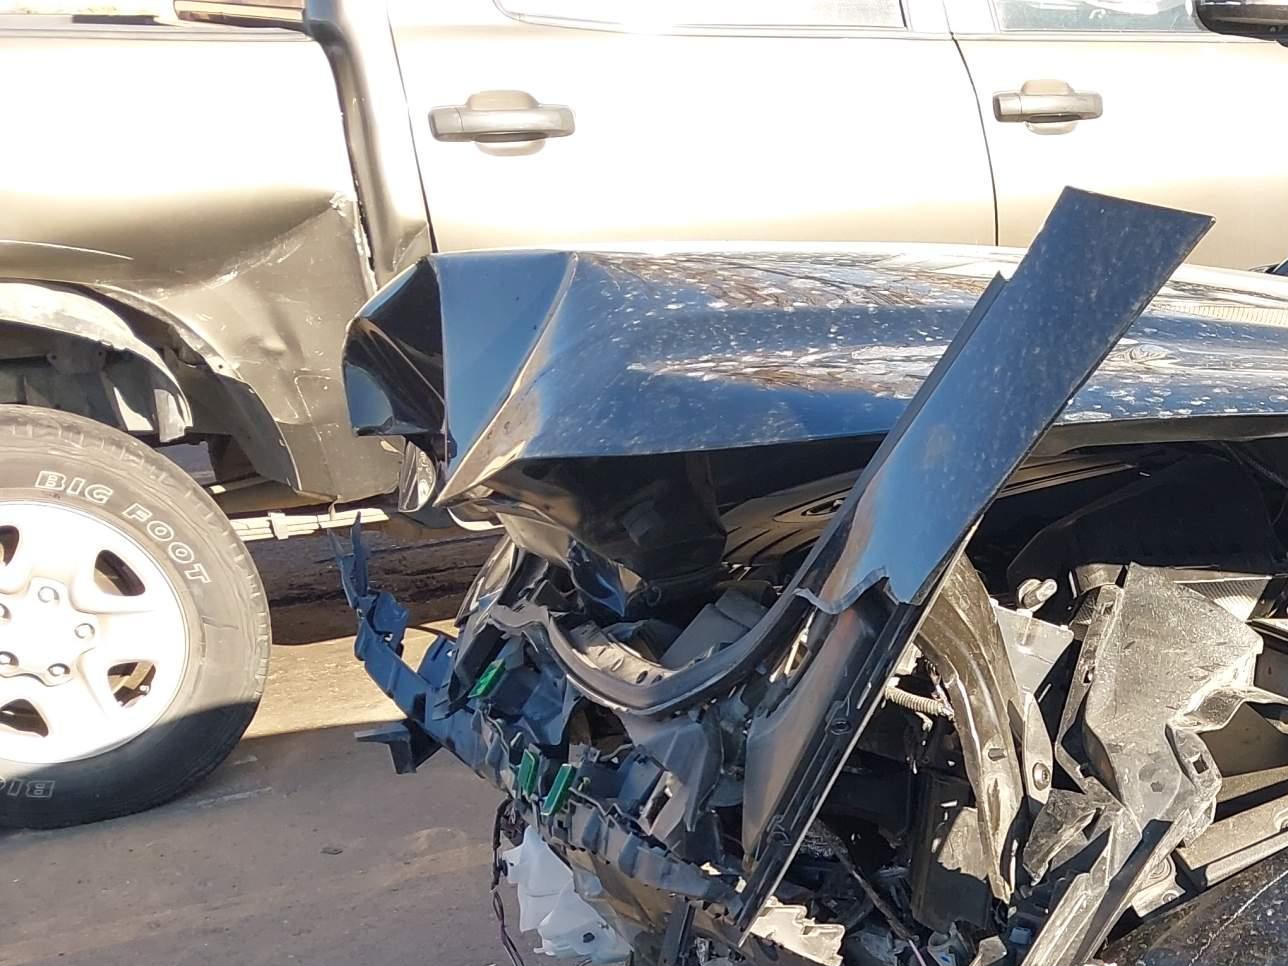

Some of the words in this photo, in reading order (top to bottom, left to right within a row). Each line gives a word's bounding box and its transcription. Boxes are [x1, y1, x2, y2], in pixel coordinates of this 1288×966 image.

[35, 471, 114, 504] BIG
[122, 503, 211, 583] FOOT
[0, 775, 56, 798] BI
